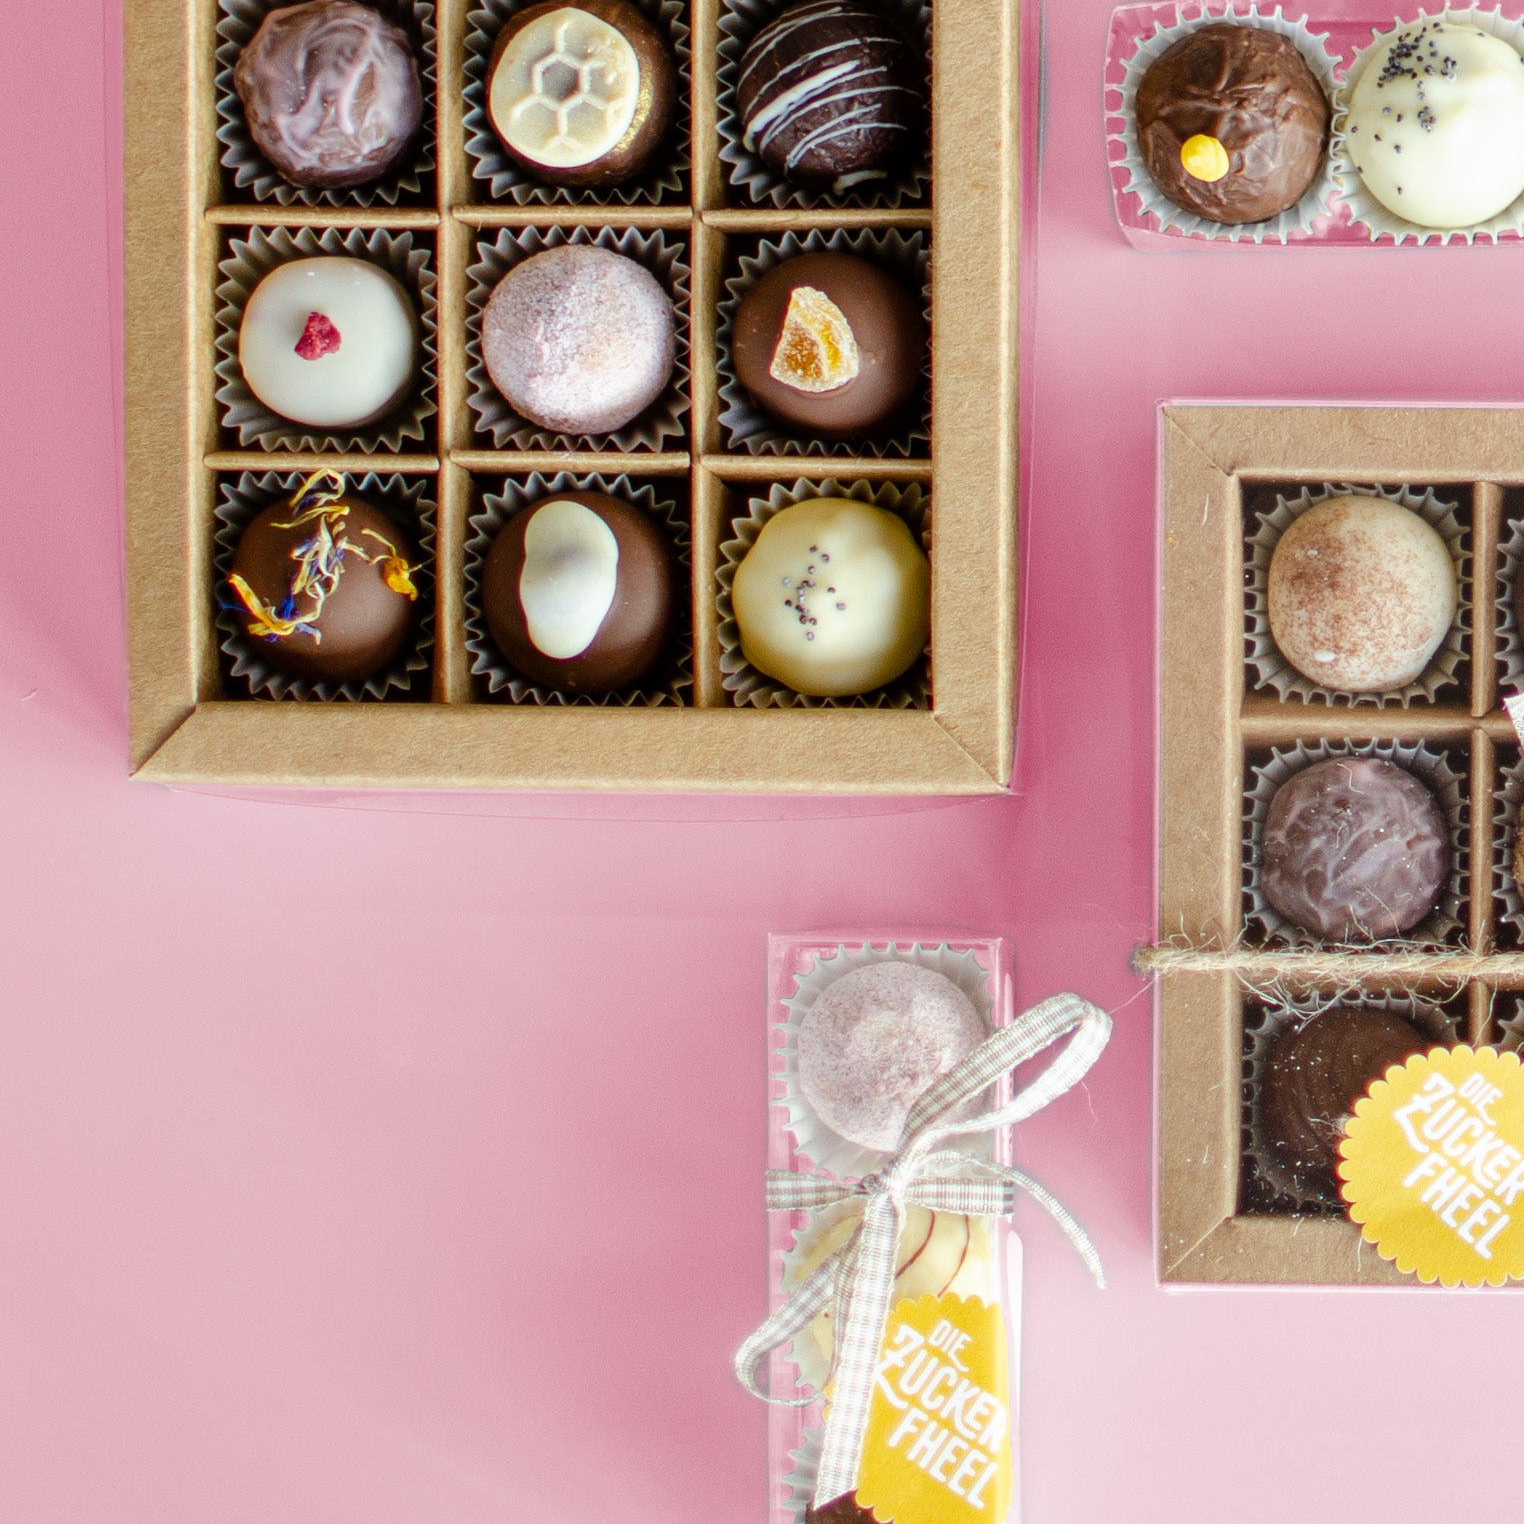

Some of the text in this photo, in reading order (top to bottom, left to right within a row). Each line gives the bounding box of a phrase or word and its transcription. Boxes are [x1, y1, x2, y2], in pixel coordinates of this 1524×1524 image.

[1458, 1072, 1504, 1126] DIE
[1403, 1152, 1511, 1260] FHEEL
[873, 1324, 1007, 1453] ZUCKER
[928, 1319, 973, 1372] DIE
[888, 1408, 999, 1510] FHEEL
